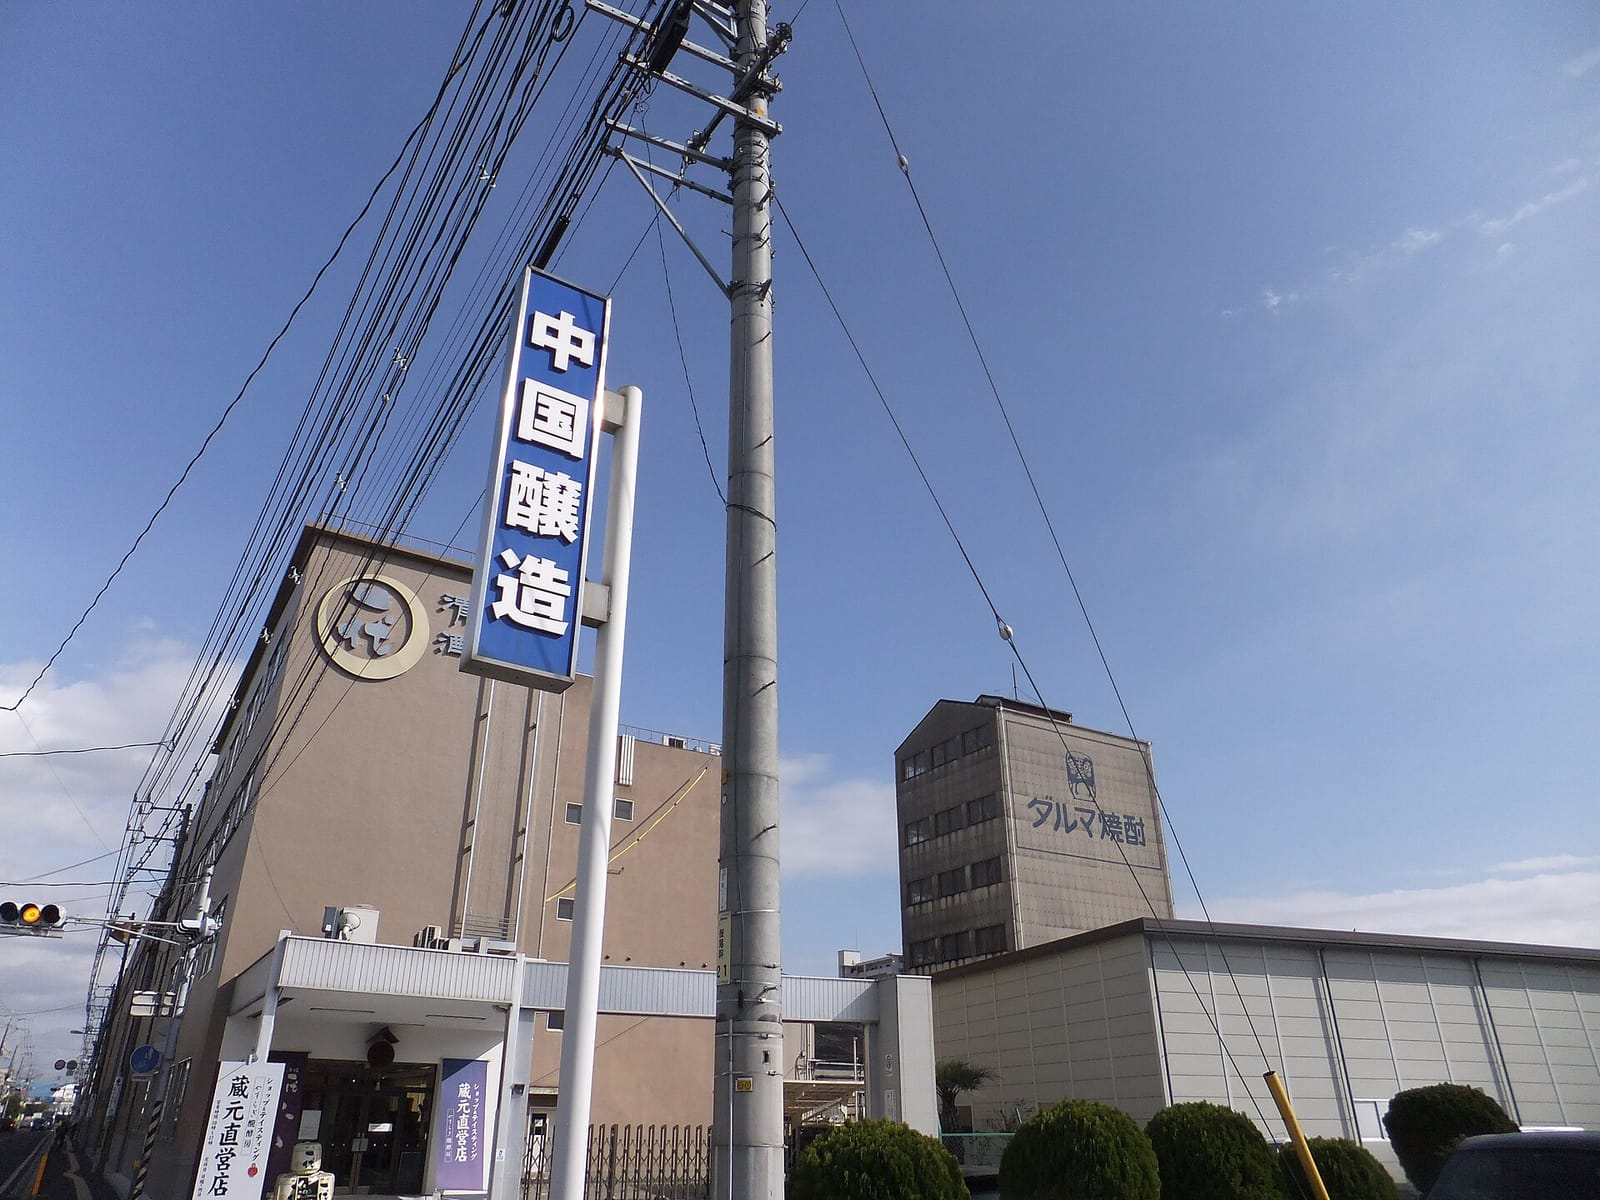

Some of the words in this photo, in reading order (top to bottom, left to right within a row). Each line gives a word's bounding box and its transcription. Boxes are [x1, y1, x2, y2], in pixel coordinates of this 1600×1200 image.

[492, 310, 595, 636] 中国醸造
[1027, 796, 1146, 847] ダルマ焼酎
[208, 1075, 250, 1197] 蔵元直営店
[455, 1082, 471, 1162] 蔵元直営店
